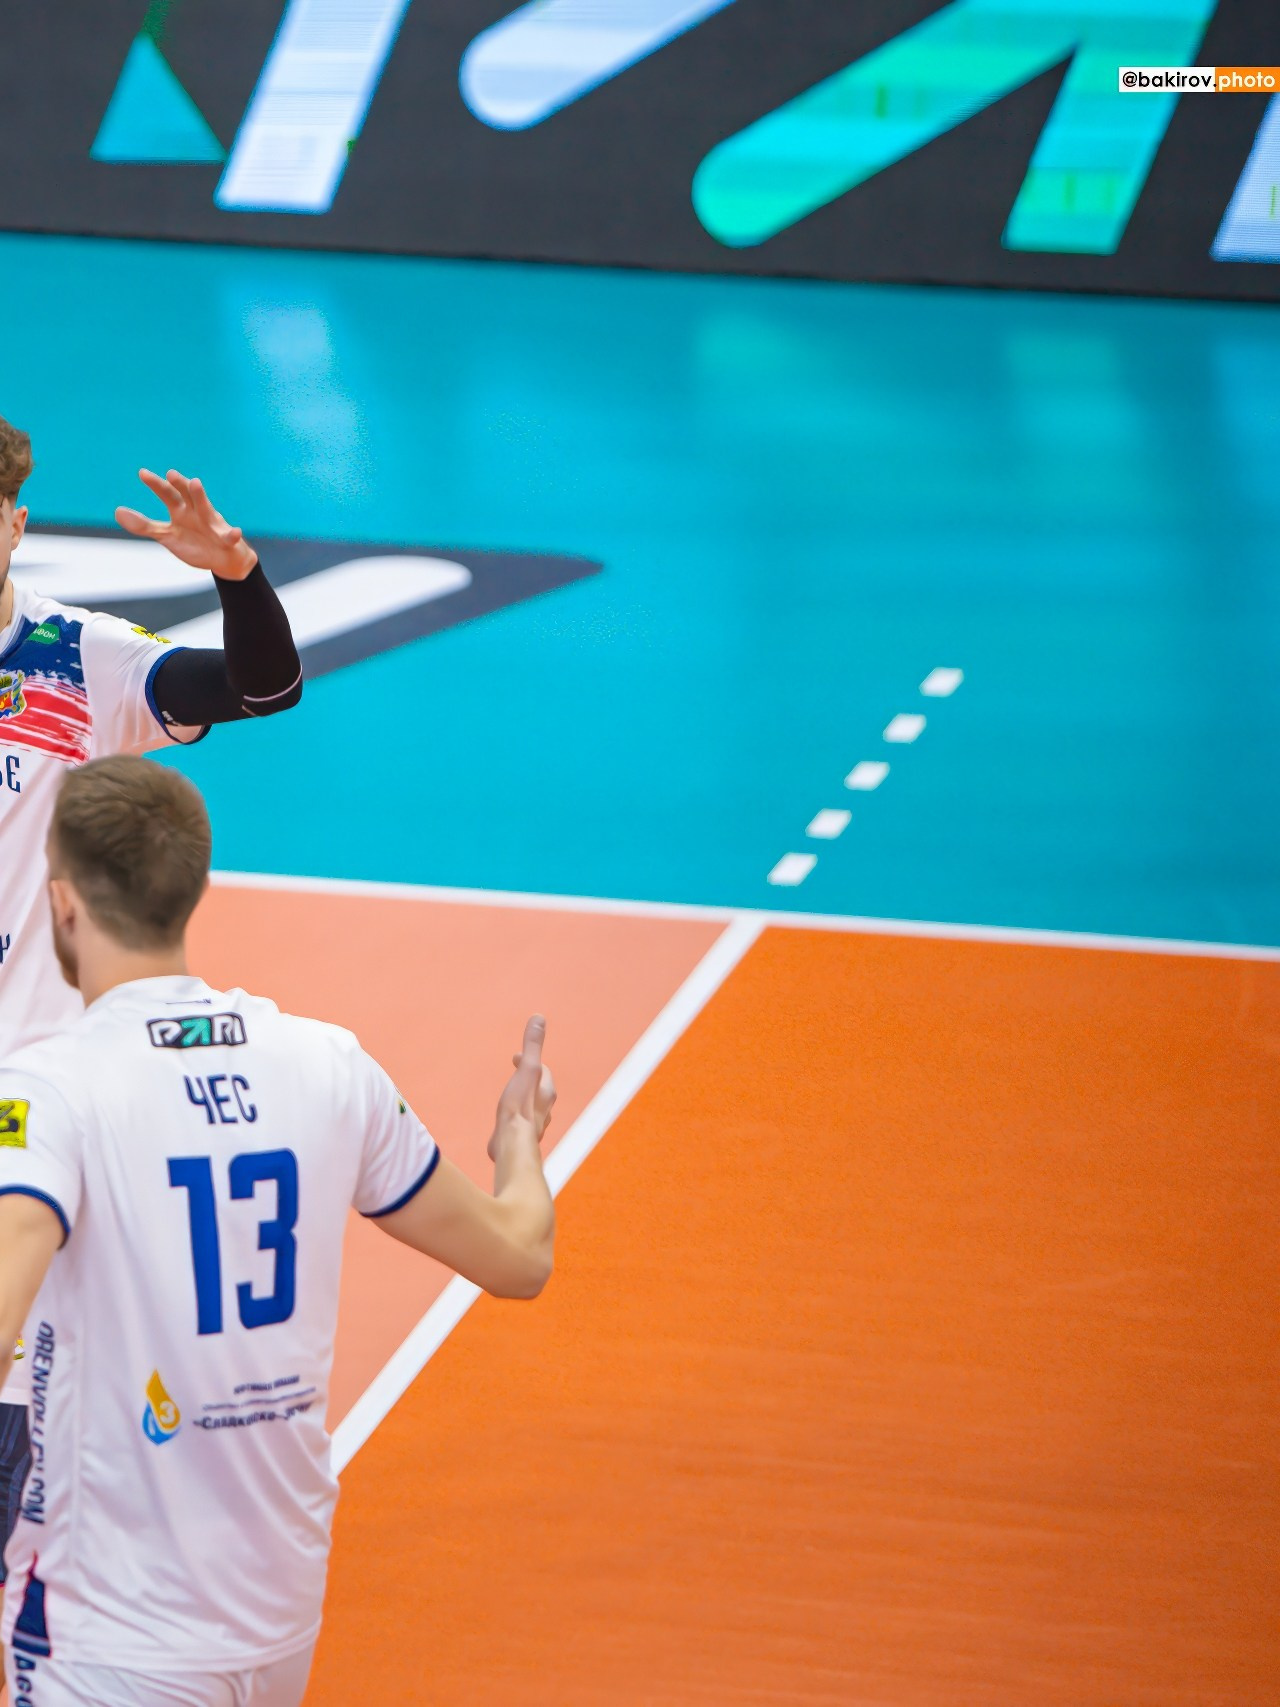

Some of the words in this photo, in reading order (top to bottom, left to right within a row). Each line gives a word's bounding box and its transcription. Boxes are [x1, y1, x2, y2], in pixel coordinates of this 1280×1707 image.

[149, 1014, 246, 1047] PARI
[183, 1073, 258, 1124] ЧЕС
[167, 1147, 299, 1336] 13
